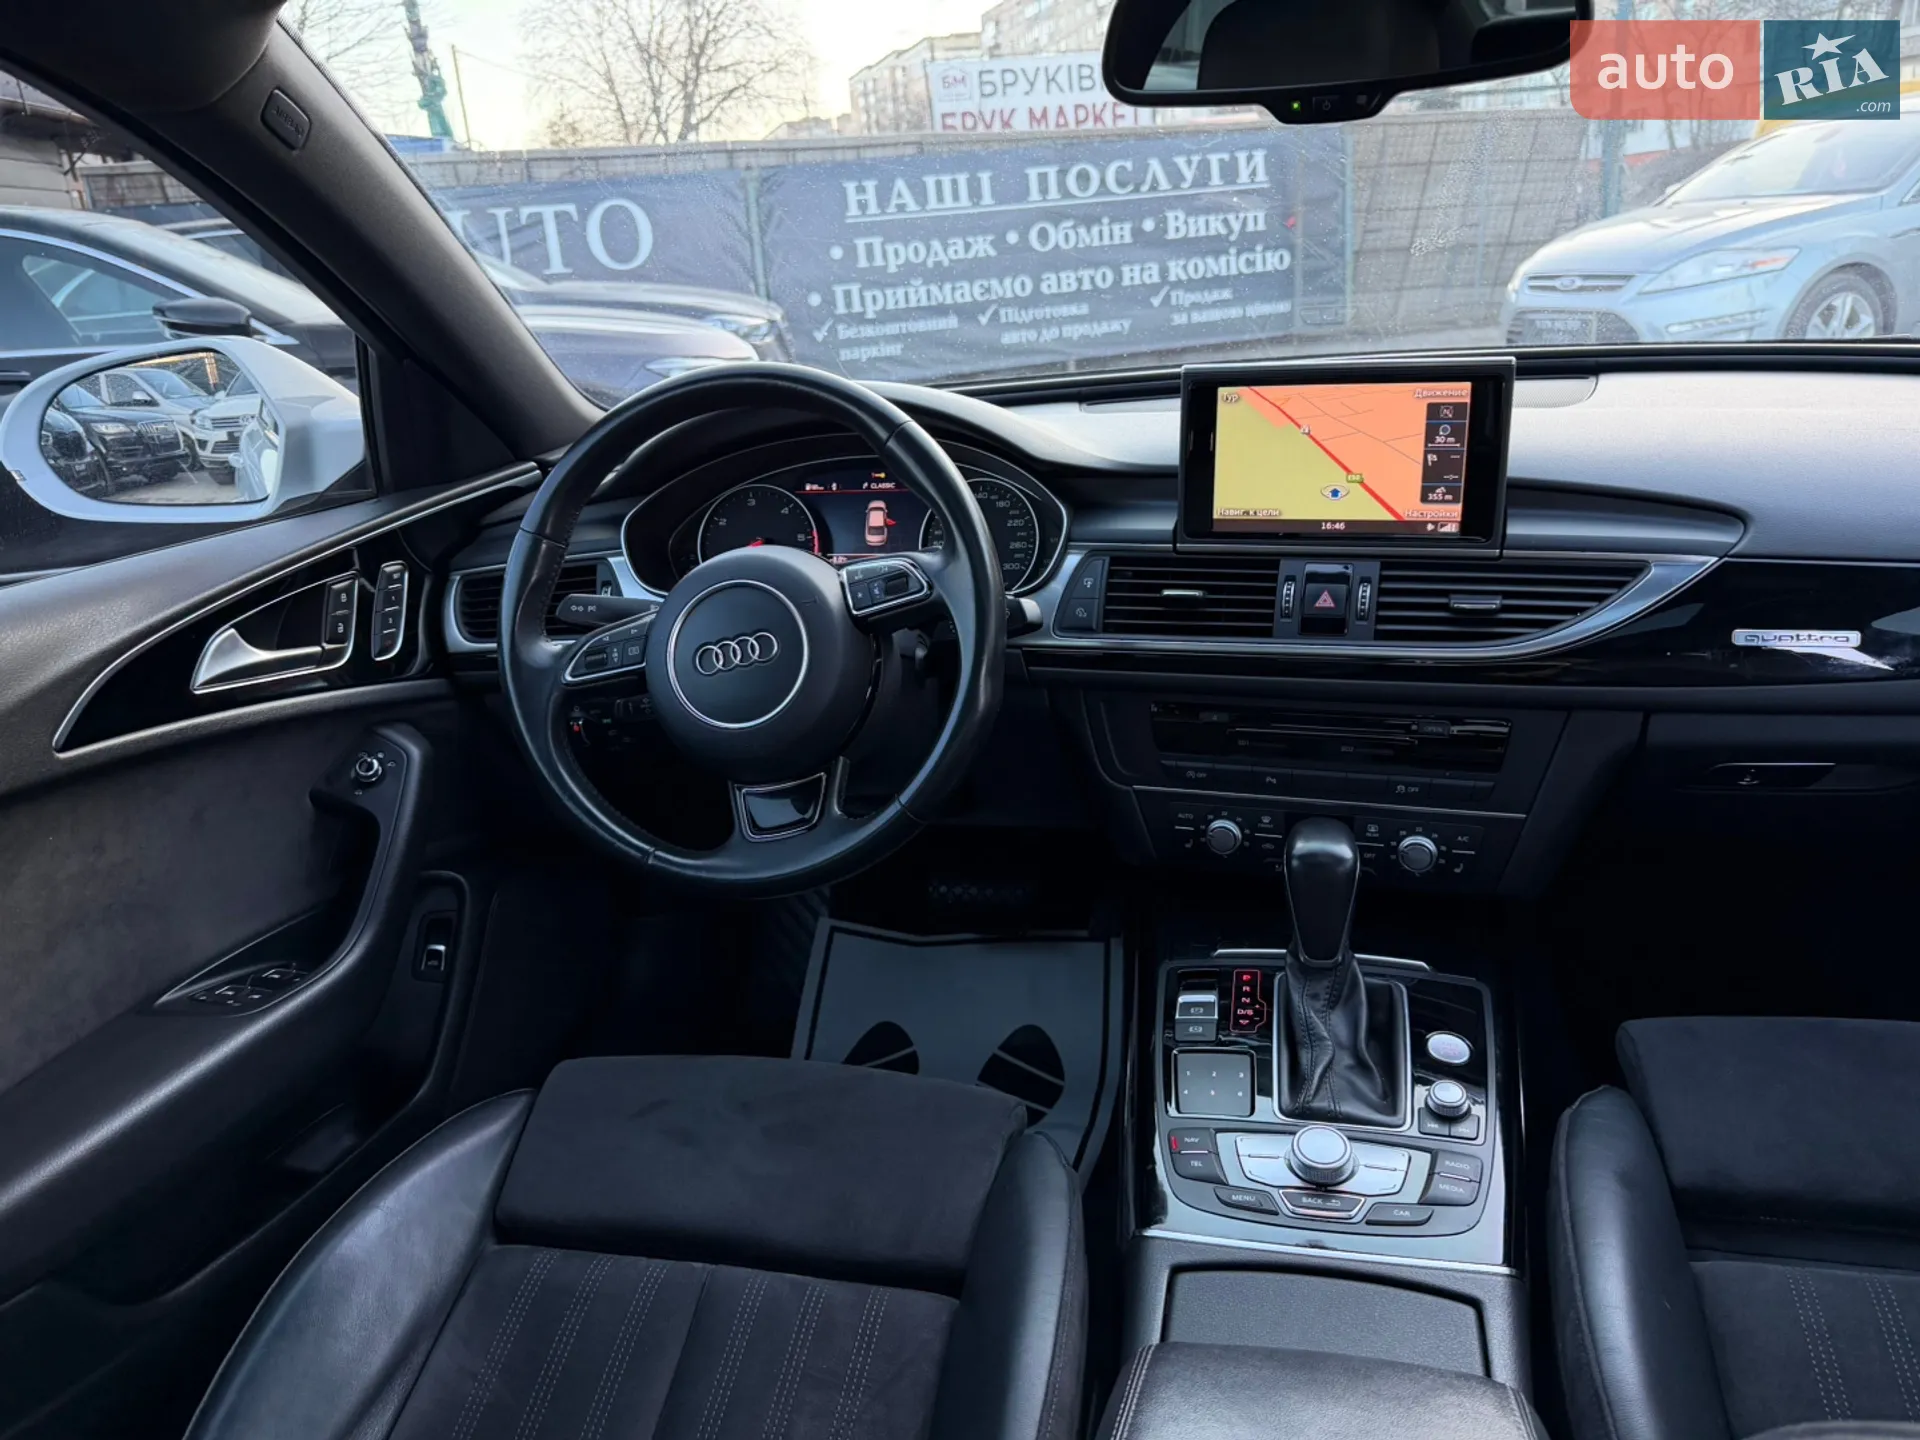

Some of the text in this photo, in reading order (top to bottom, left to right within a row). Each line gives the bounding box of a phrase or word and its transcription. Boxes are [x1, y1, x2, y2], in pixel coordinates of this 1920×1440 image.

[978, 62, 1105, 98] БРУКІВ
[841, 149, 1270, 217] НАШІ ПОСЛУГИ
[853, 208, 1268, 274] Продаж Обмін Викуп
[832, 244, 1291, 319] Приймаємо авто на комісію
[1414, 388, 1468, 399] Движение
[1435, 436, 1446, 444] 30
[1428, 493, 1443, 501] 355
[747, 498, 756, 506] 3
[780, 506, 789, 514] 4
[1217, 507, 1246, 516] Навиг.
[1257, 508, 1280, 518] цели
[1405, 508, 1459, 519] Настройки
[718, 518, 727, 526] 2
[1007, 519, 1024, 527] 220
[1321, 521, 1345, 530] 16:46
[797, 533, 806, 541] 5
[1009, 541, 1027, 549] 260
[1743, 633, 1850, 645] quattro
[1444, 1159, 1470, 1170] RADIO
[1438, 1183, 1465, 1194] MEDIA
[1231, 1194, 1256, 1202] MENU
[1301, 1197, 1324, 1205] BACK
[1393, 1209, 1411, 1217] CAR
